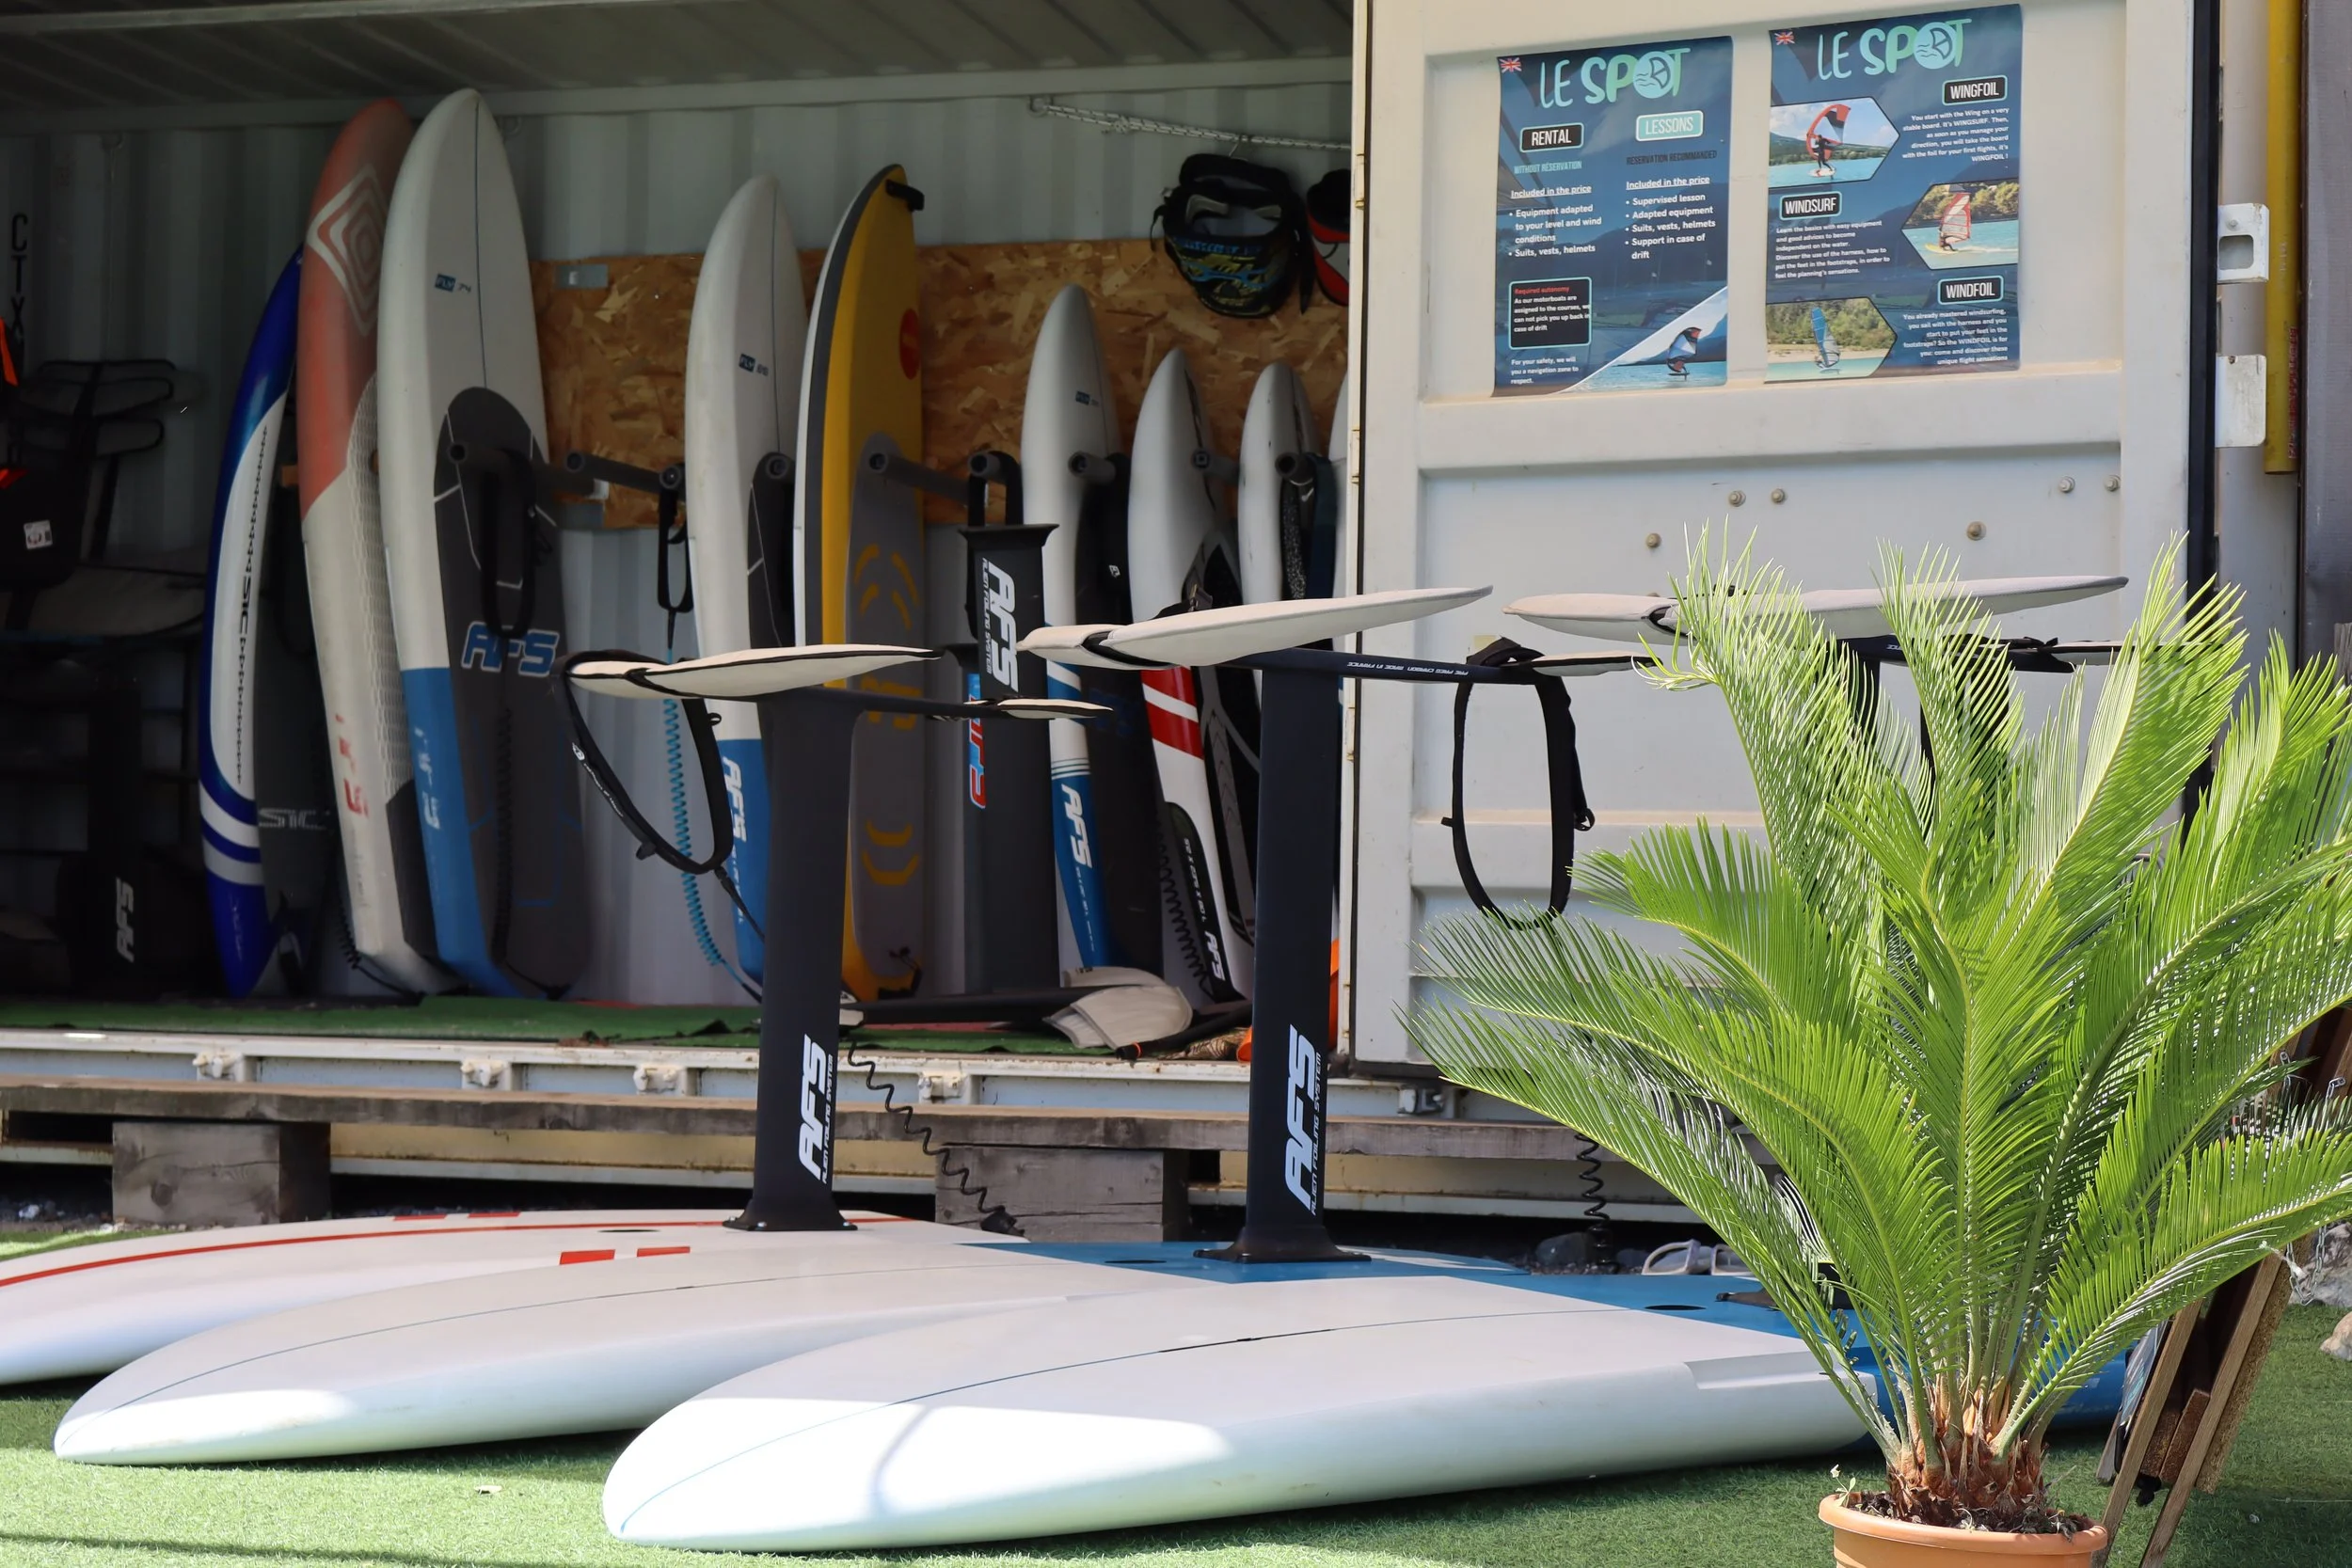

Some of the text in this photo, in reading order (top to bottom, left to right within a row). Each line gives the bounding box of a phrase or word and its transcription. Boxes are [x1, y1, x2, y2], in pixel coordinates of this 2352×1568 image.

[1817, 18, 1972, 80] LE SPOT
[1540, 47, 1691, 108] LE SPOT
[1950, 81, 1999, 99] WINGFOIL
[1645, 116, 1693, 135] LESSONS
[1532, 129, 1571, 146] RENTAL
[1514, 165, 1540, 174] WITHOUT
[1511, 185, 1592, 198] Included in the price
[1626, 180, 1661, 190] Included
[1673, 178, 1686, 186] the
[1689, 176, 1710, 186] price
[1632, 195, 1677, 206] Supervised
[1785, 197, 1836, 214] WINDSURF
[1516, 204, 1593, 218] Equipment adapted
[1632, 206, 1713, 220] Adapted equipment
[1632, 224, 1655, 232] Suits,
[1683, 220, 1716, 229] helmets
[1515, 235, 1556, 244] conditions
[1631, 236, 1664, 246] Support
[1515, 248, 1536, 257] Suits,
[1564, 245, 1596, 253] helmets
[1631, 251, 1649, 260] drift
[1946, 282, 1995, 299] WINDFOIL
[989, 562, 1018, 692] AFS
[723, 756, 747, 842] AFS
[1061, 784, 1092, 868] AFS
[116, 877, 135, 963] AFS
[1205, 931, 1225, 981] AFS
[799, 1034, 826, 1180] AFS
[1285, 1023, 1315, 1212] AFS
